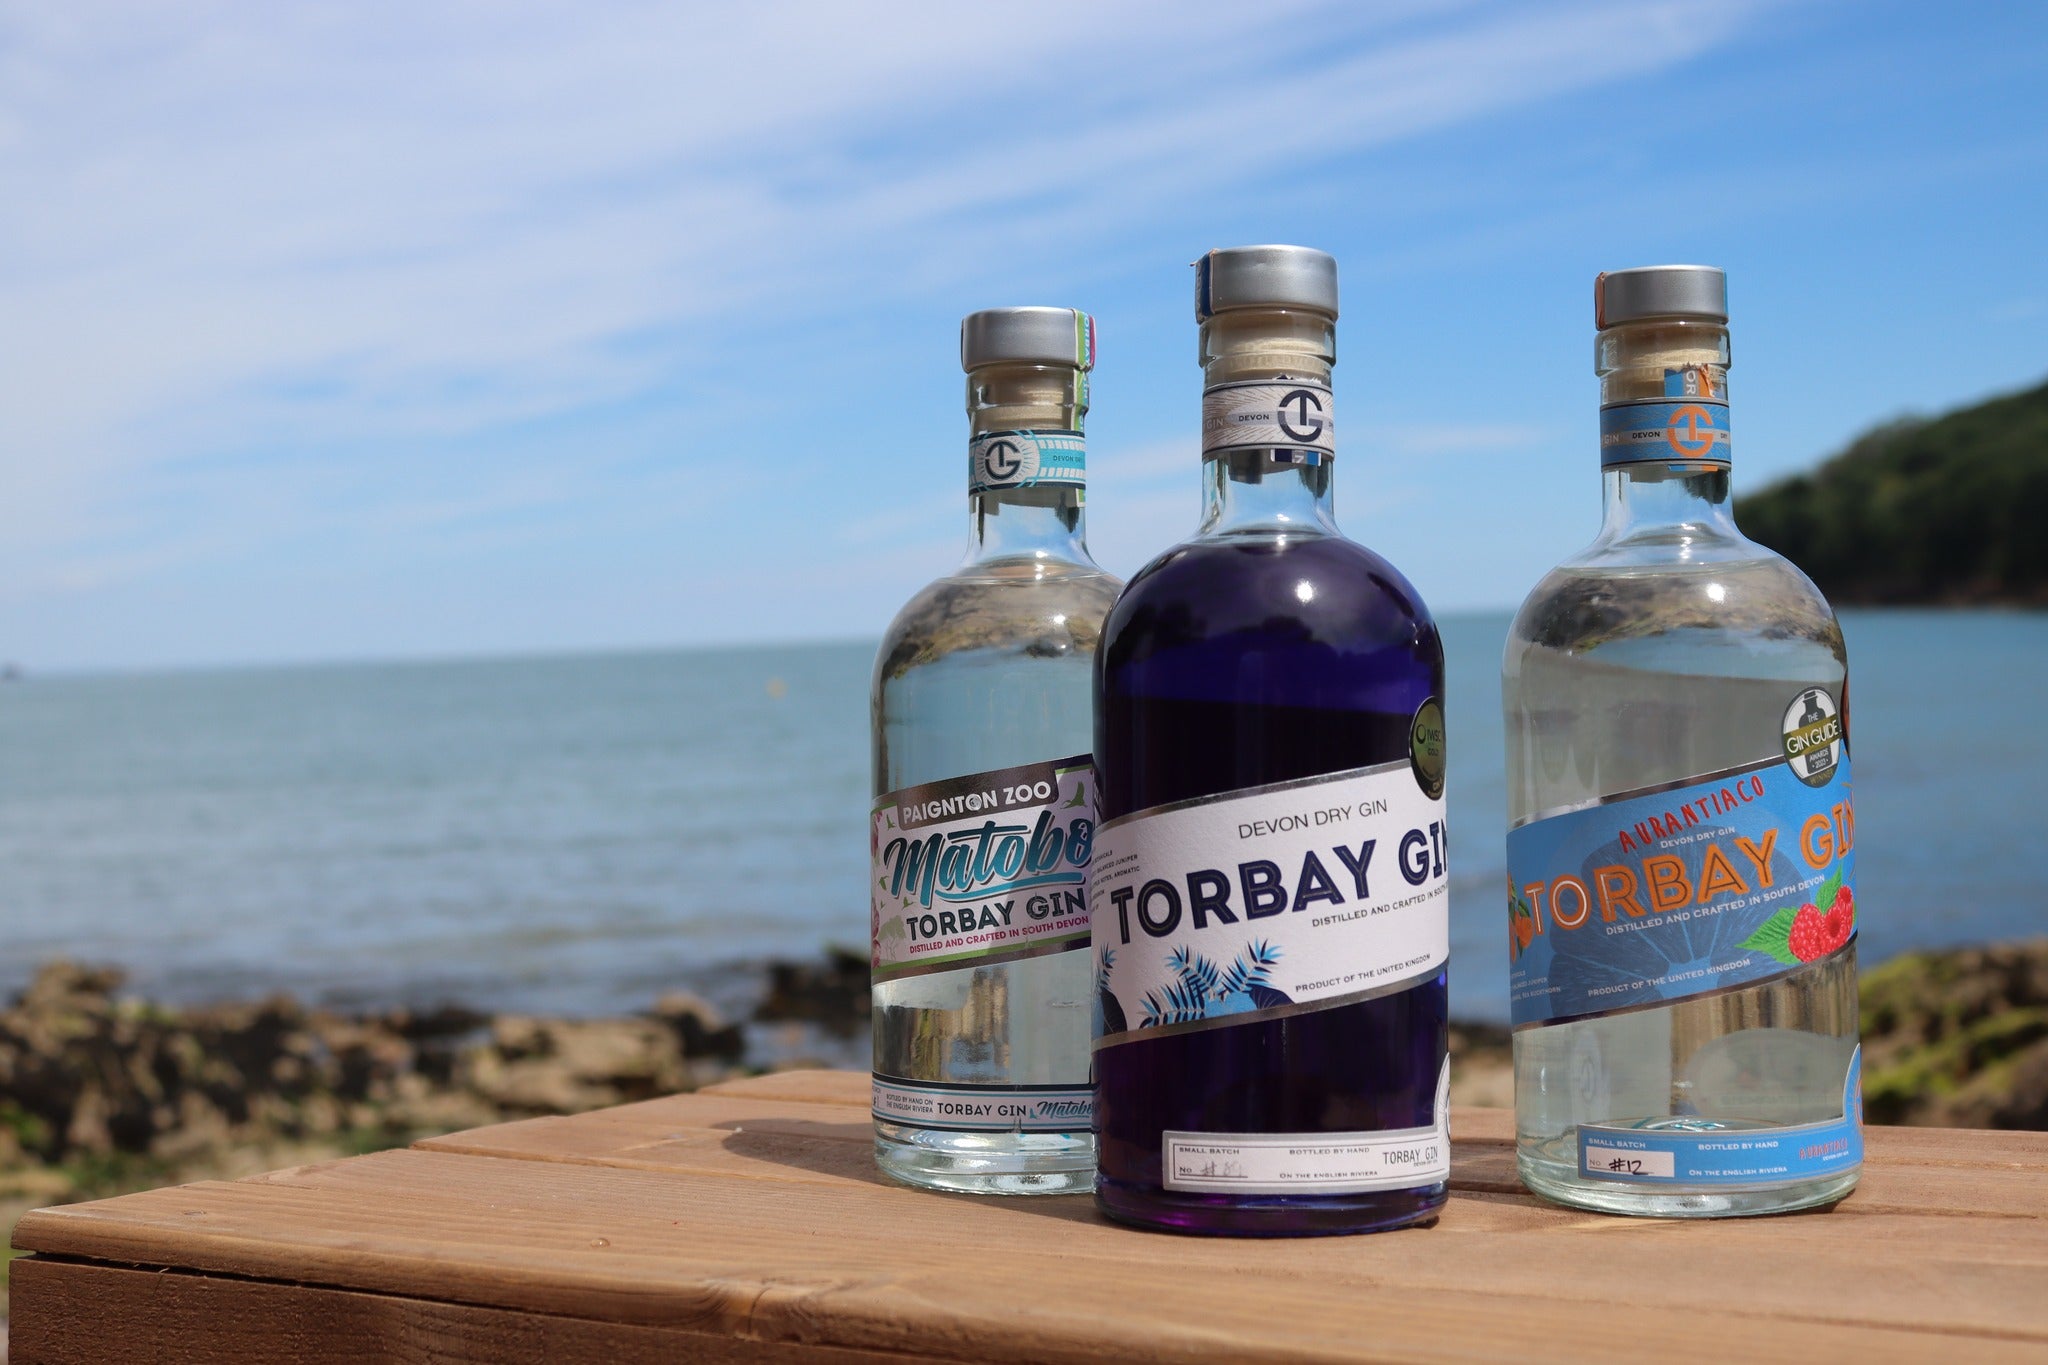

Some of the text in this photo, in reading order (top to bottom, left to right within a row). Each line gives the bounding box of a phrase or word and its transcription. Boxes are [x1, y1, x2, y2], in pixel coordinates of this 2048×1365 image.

[1632, 431, 1660, 439] DEVON
[1787, 720, 1838, 753] GIN GUIDE
[1807, 712, 1819, 723] THE
[903, 781, 1051, 824] PAIGNTON ZOO
[1238, 799, 1388, 839] DEVON DRY GIN
[1619, 775, 1765, 854] AURANTIACO
[1660, 826, 1735, 849] DEVON DRY GIN
[883, 811, 1093, 909] Matobo
[1111, 839, 1377, 945] TORBAY
[1524, 828, 1778, 936] TORBAY
[906, 888, 1086, 941] TORBAY GIN
[1311, 909, 1368, 928] DISTILLED
[1370, 903, 1390, 917] AND
[1392, 894, 1426, 911] CRAFTED
[1427, 890, 1434, 899] IN
[1606, 874, 1825, 936] DISTILLED AND CRAFTED IN SOUTH DEVON
[910, 916, 1089, 954] DISTILLED AND CRAFTED IN SOUTH DEVON
[1295, 953, 1431, 992] PRODUCT OF THE UNITED KINGDOM
[1587, 959, 1751, 998] PRODUCT OF THE UNITED KINGDOM
[912, 1105, 934, 1113] RIVIERA
[937, 1103, 1026, 1117] TORBAY GIN
[1383, 1146, 1438, 1165] TORBAY GIN
[1588, 1138, 1646, 1149] SMALL BATCH
[1589, 1158, 1601, 1166] No
[1609, 1160, 1645, 1175] #12
[1723, 1167, 1757, 1175] ENGLISH
